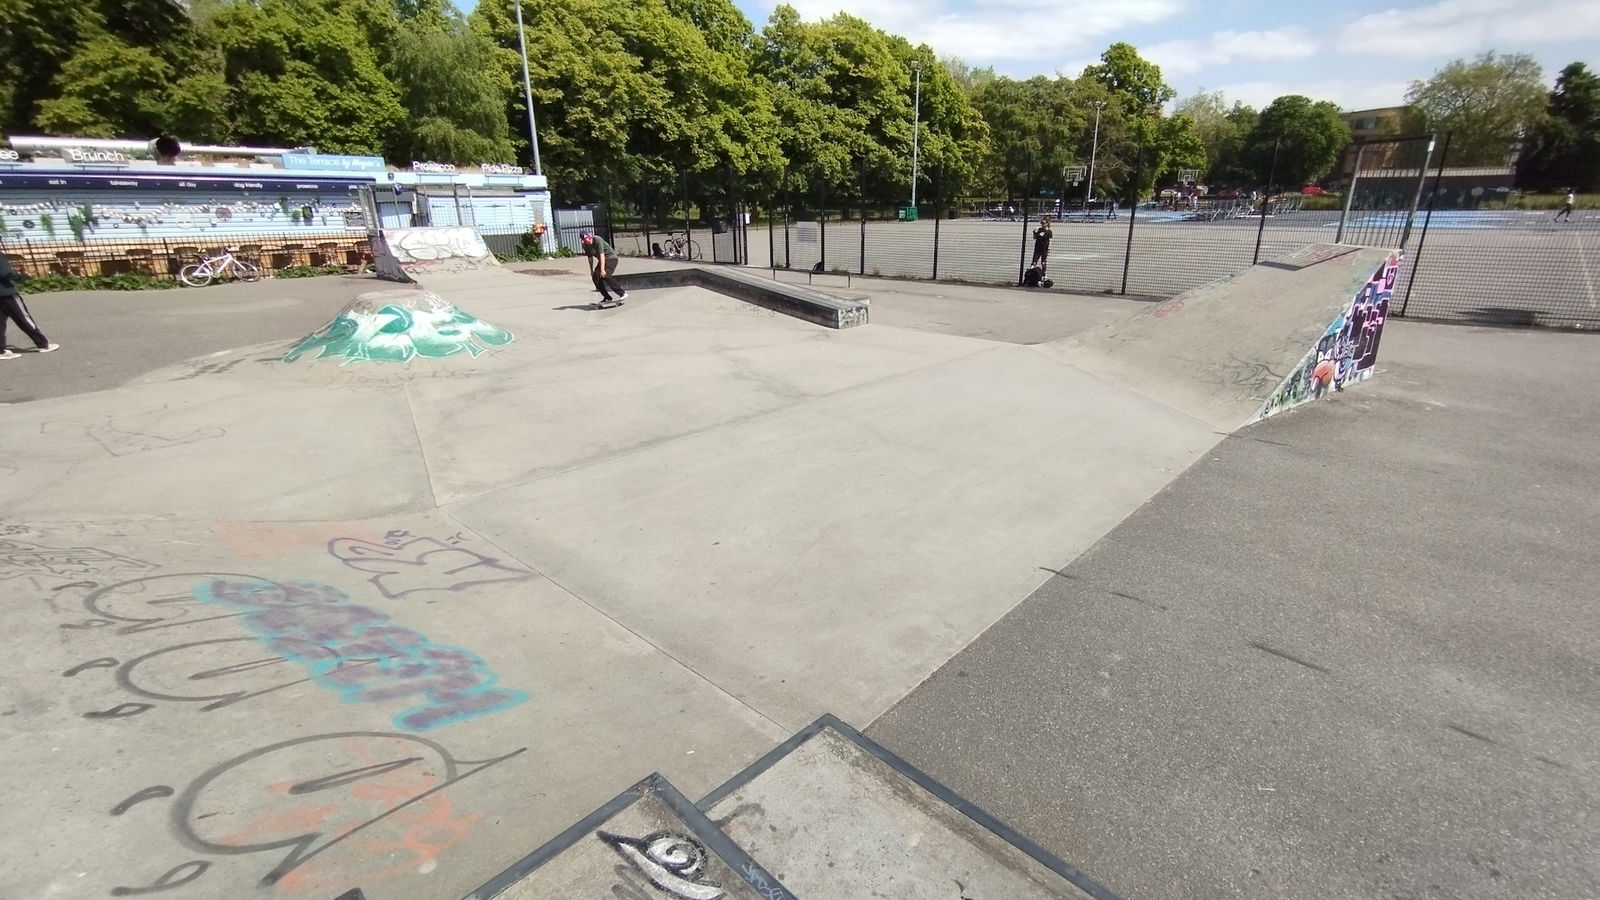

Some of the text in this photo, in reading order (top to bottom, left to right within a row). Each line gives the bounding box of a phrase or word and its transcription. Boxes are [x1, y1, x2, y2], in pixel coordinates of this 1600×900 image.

[72, 148, 124, 161] Brunch
[288, 156, 305, 164] The
[309, 157, 340, 166] Terrace
[342, 158, 351, 169] by
[413, 161, 455, 172] Prosecco
[502, 164, 522, 174] Pizza
